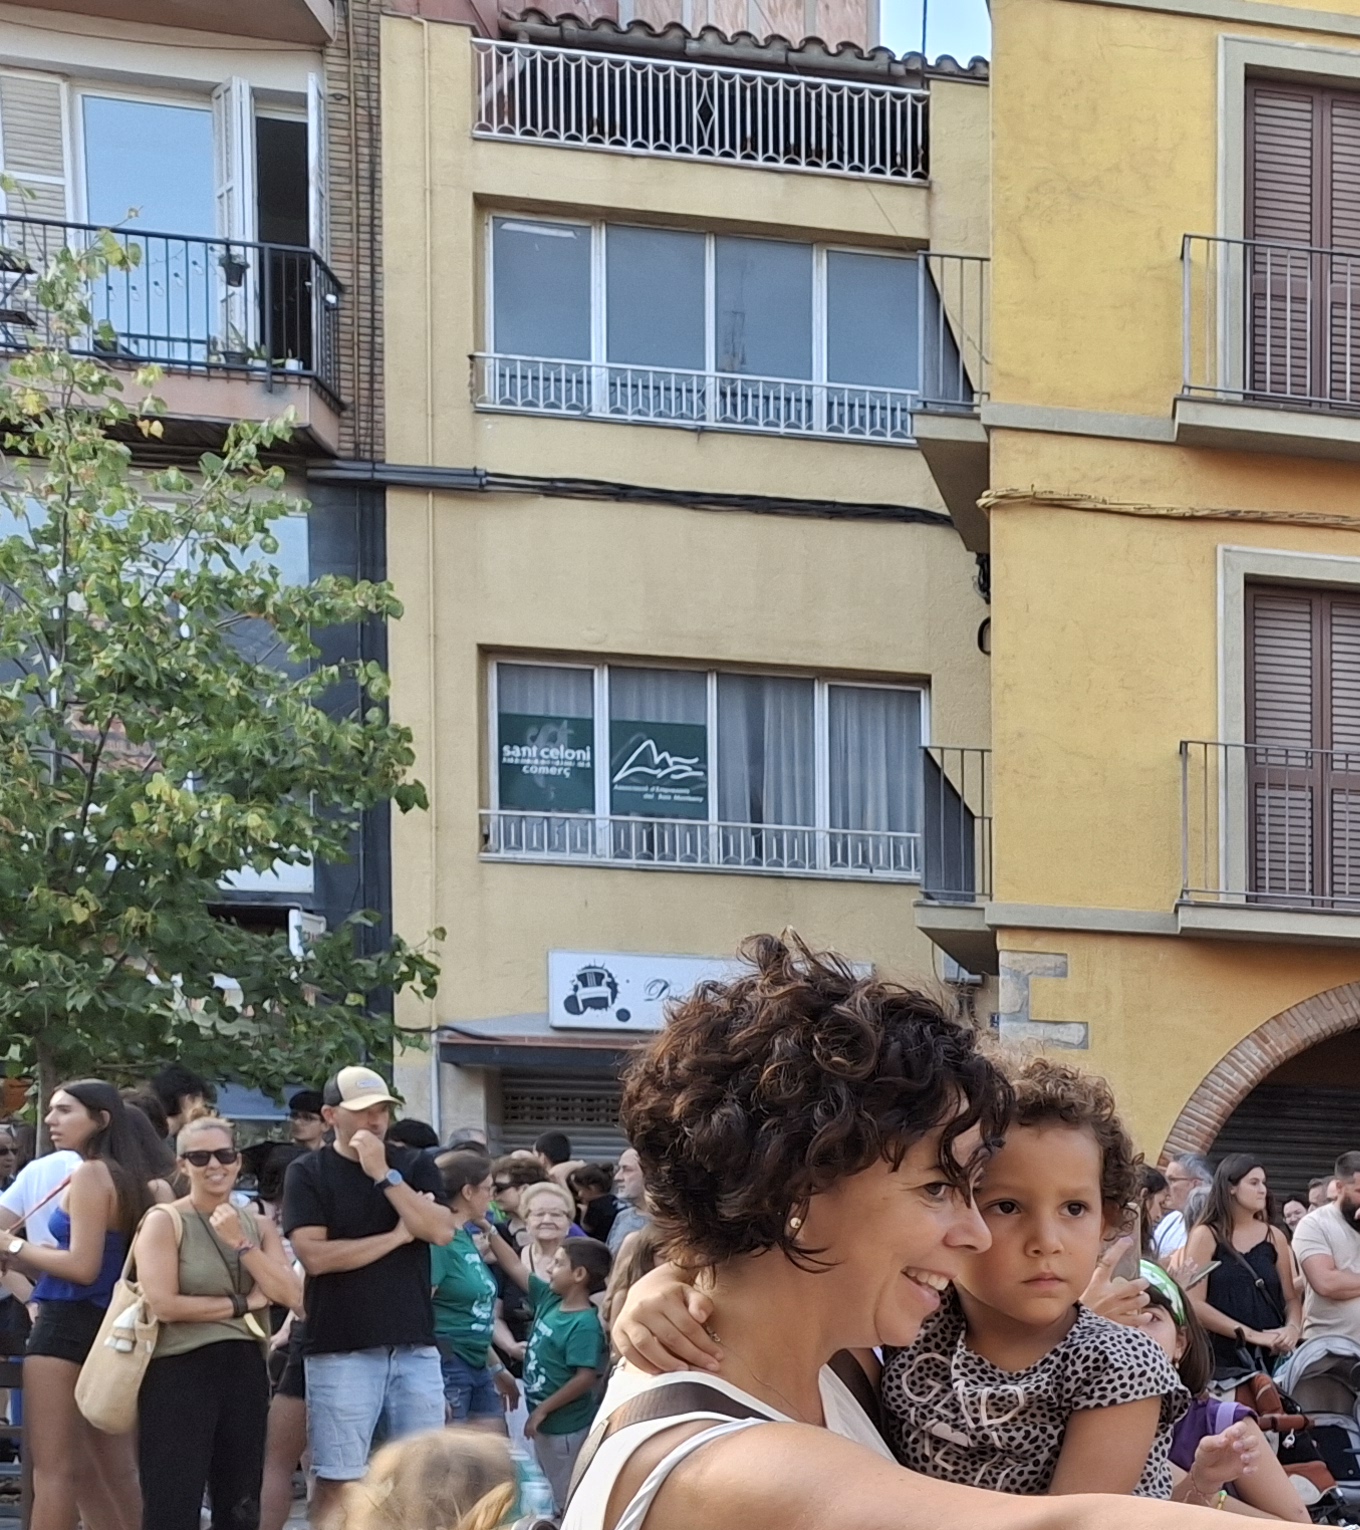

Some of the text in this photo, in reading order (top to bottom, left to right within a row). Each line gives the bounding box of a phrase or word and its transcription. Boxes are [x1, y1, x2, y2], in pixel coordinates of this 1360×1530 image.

[502, 744, 591, 761] sant celoni
[522, 764, 571, 779] comerç
